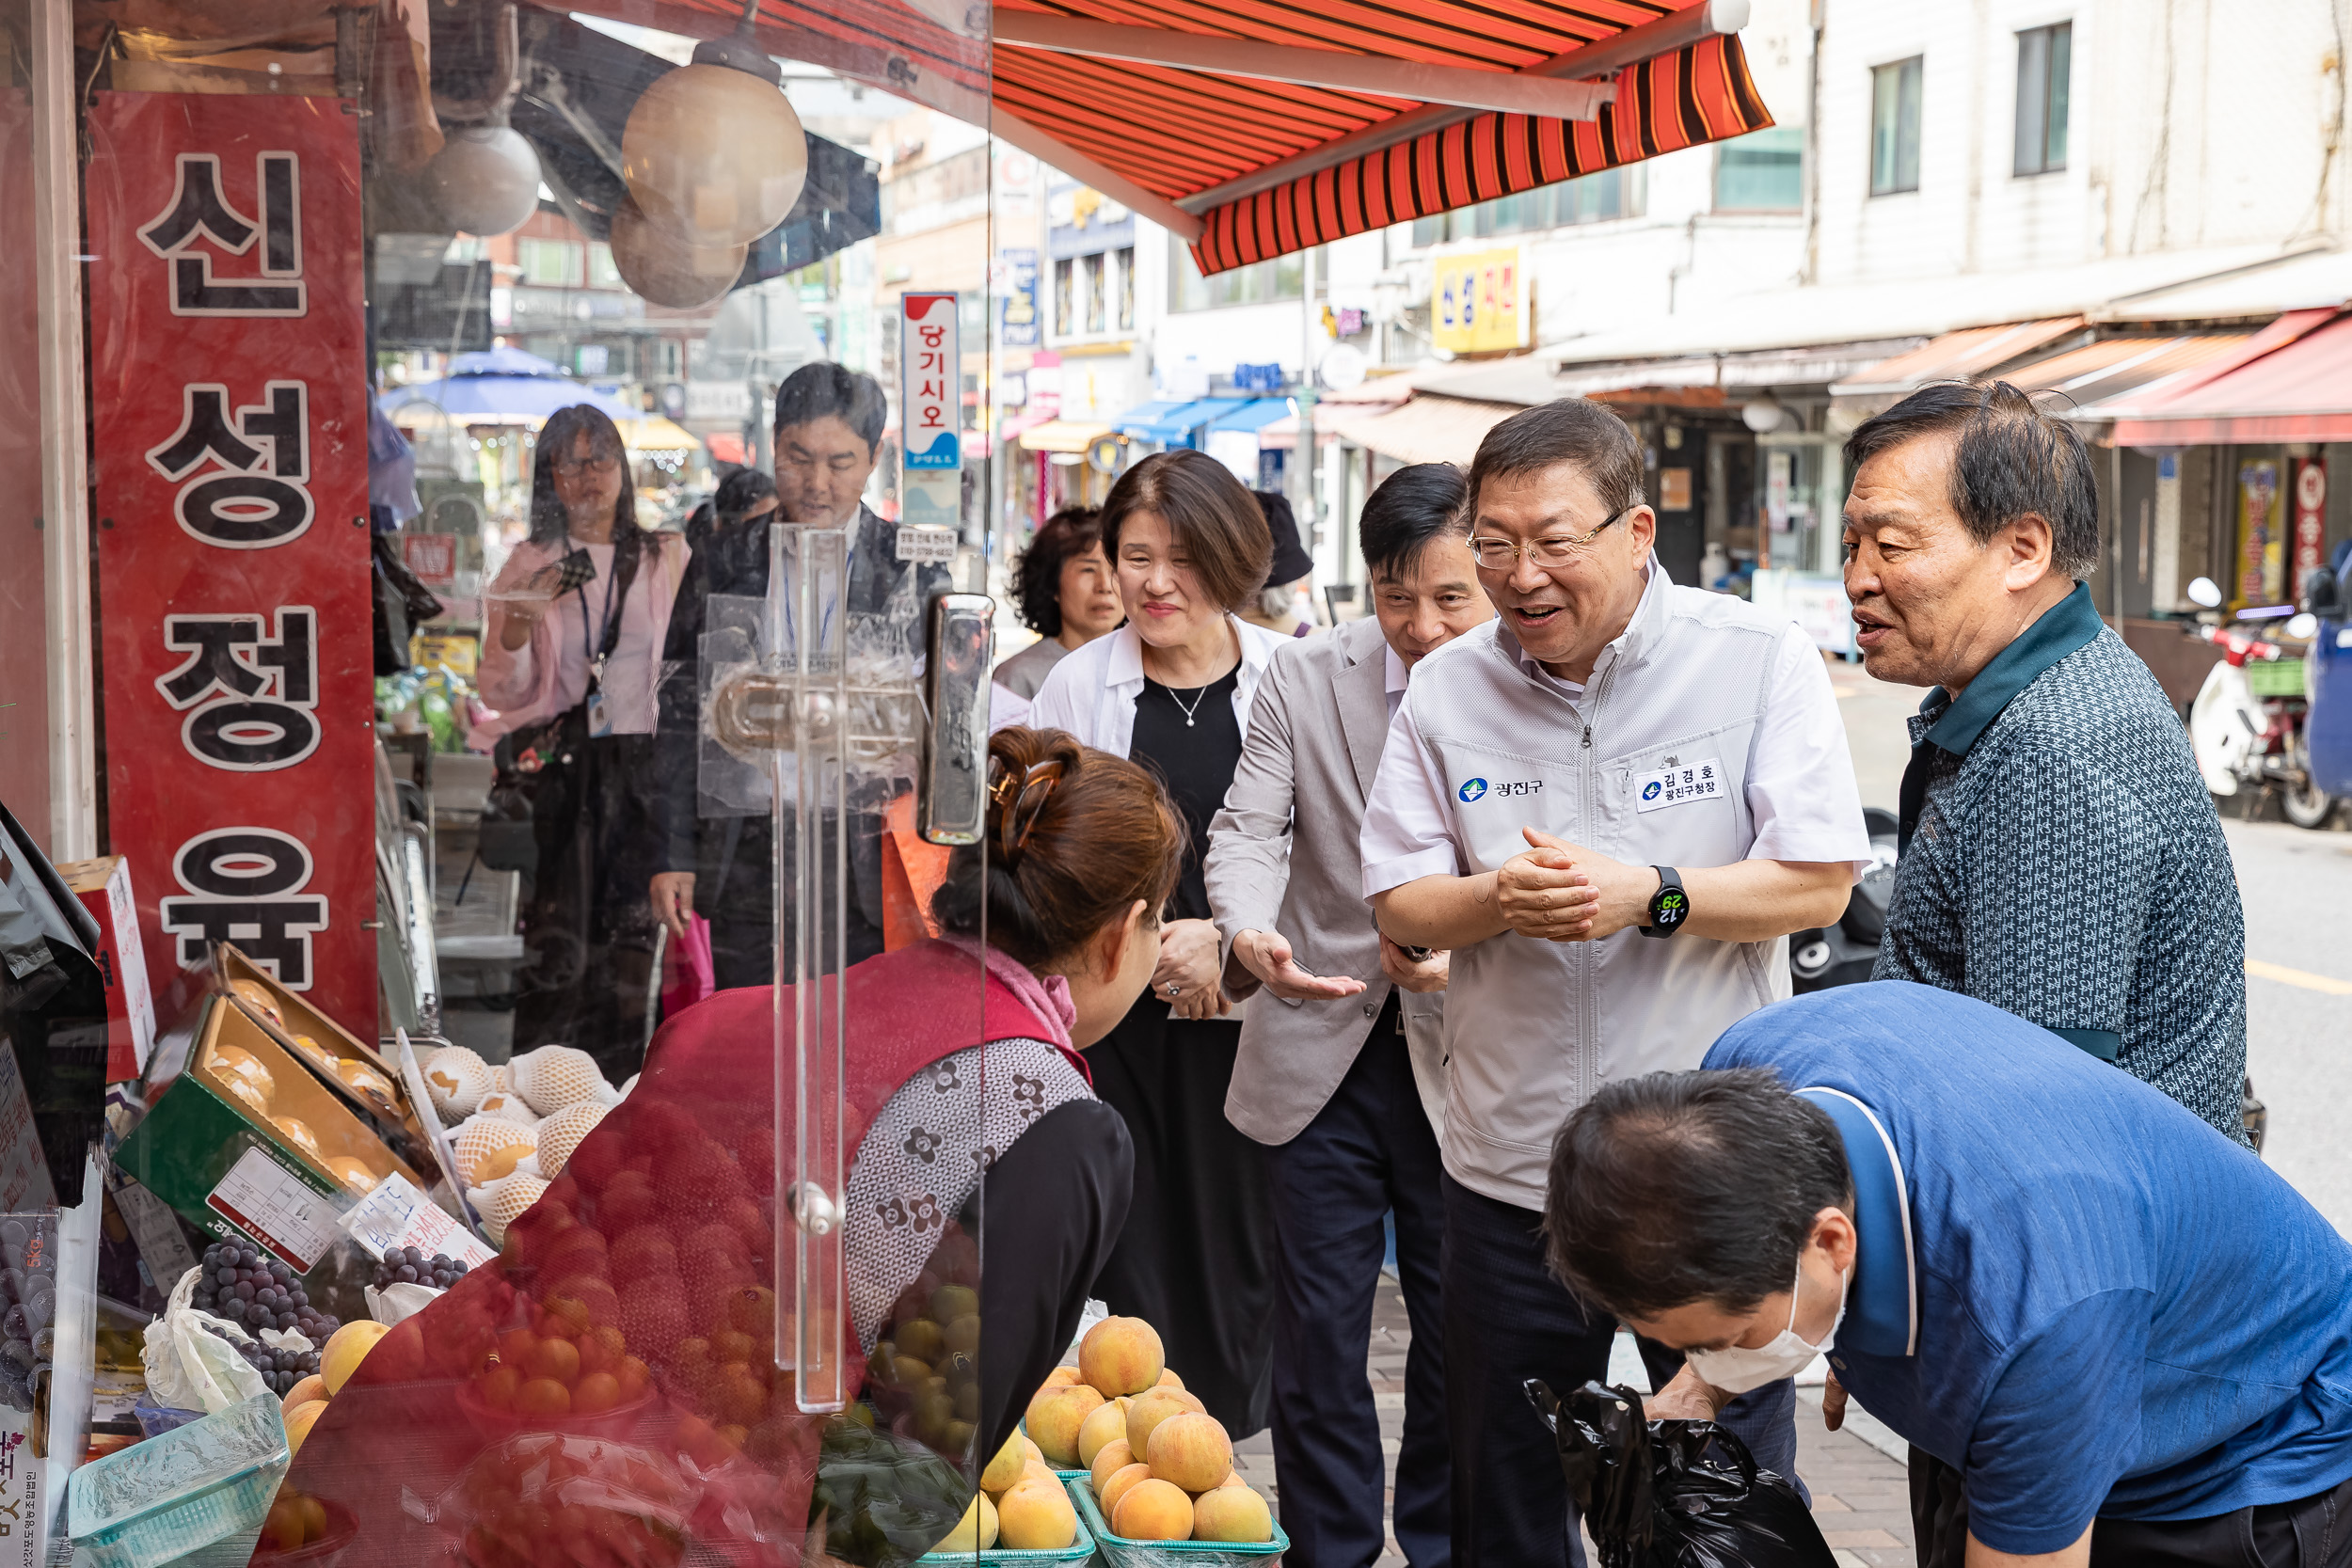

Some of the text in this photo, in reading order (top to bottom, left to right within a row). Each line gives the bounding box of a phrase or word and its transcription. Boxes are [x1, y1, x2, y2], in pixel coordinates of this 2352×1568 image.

[919, 325, 946, 428] 당기시오
[1493, 780, 1544, 798] 광진구
[1665, 781, 1716, 800] 광진구청장
